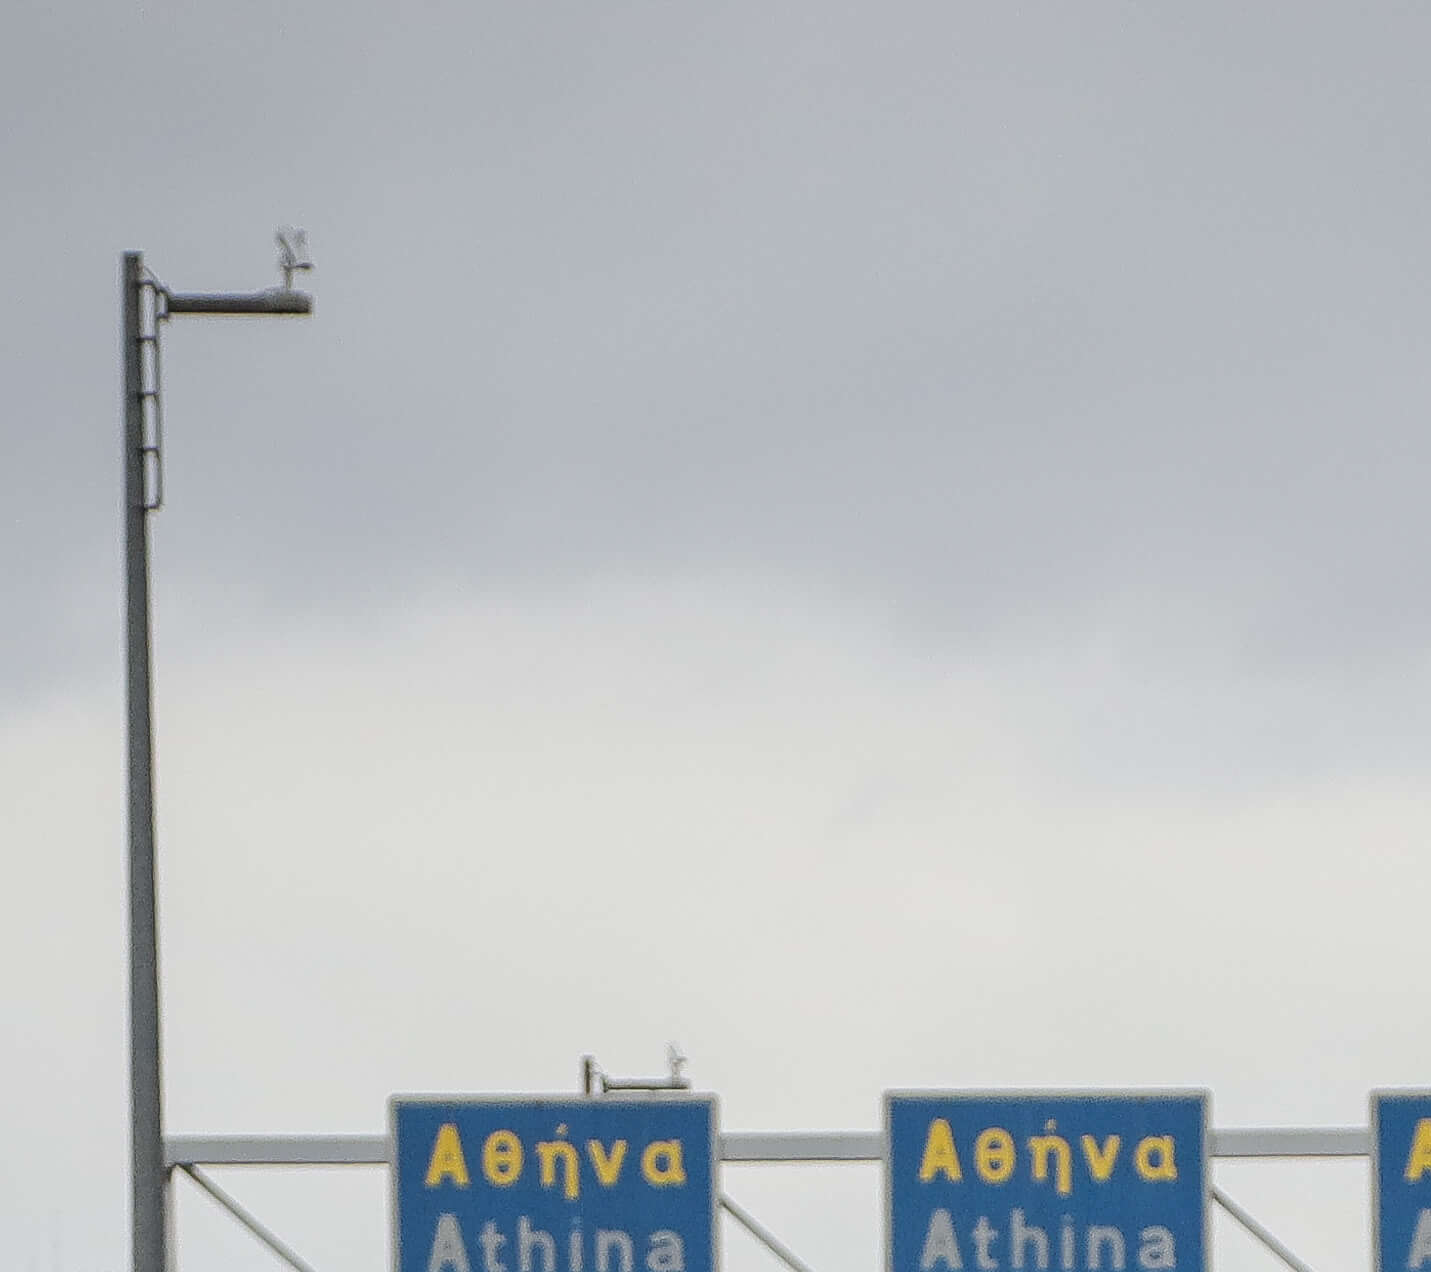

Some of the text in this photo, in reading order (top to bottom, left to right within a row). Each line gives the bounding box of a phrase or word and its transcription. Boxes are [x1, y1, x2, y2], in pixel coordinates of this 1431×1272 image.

[425, 1121, 687, 1200] Αθήνα
[919, 1117, 1179, 1195] Αθήνα
[919, 1207, 1177, 1272] Athina
